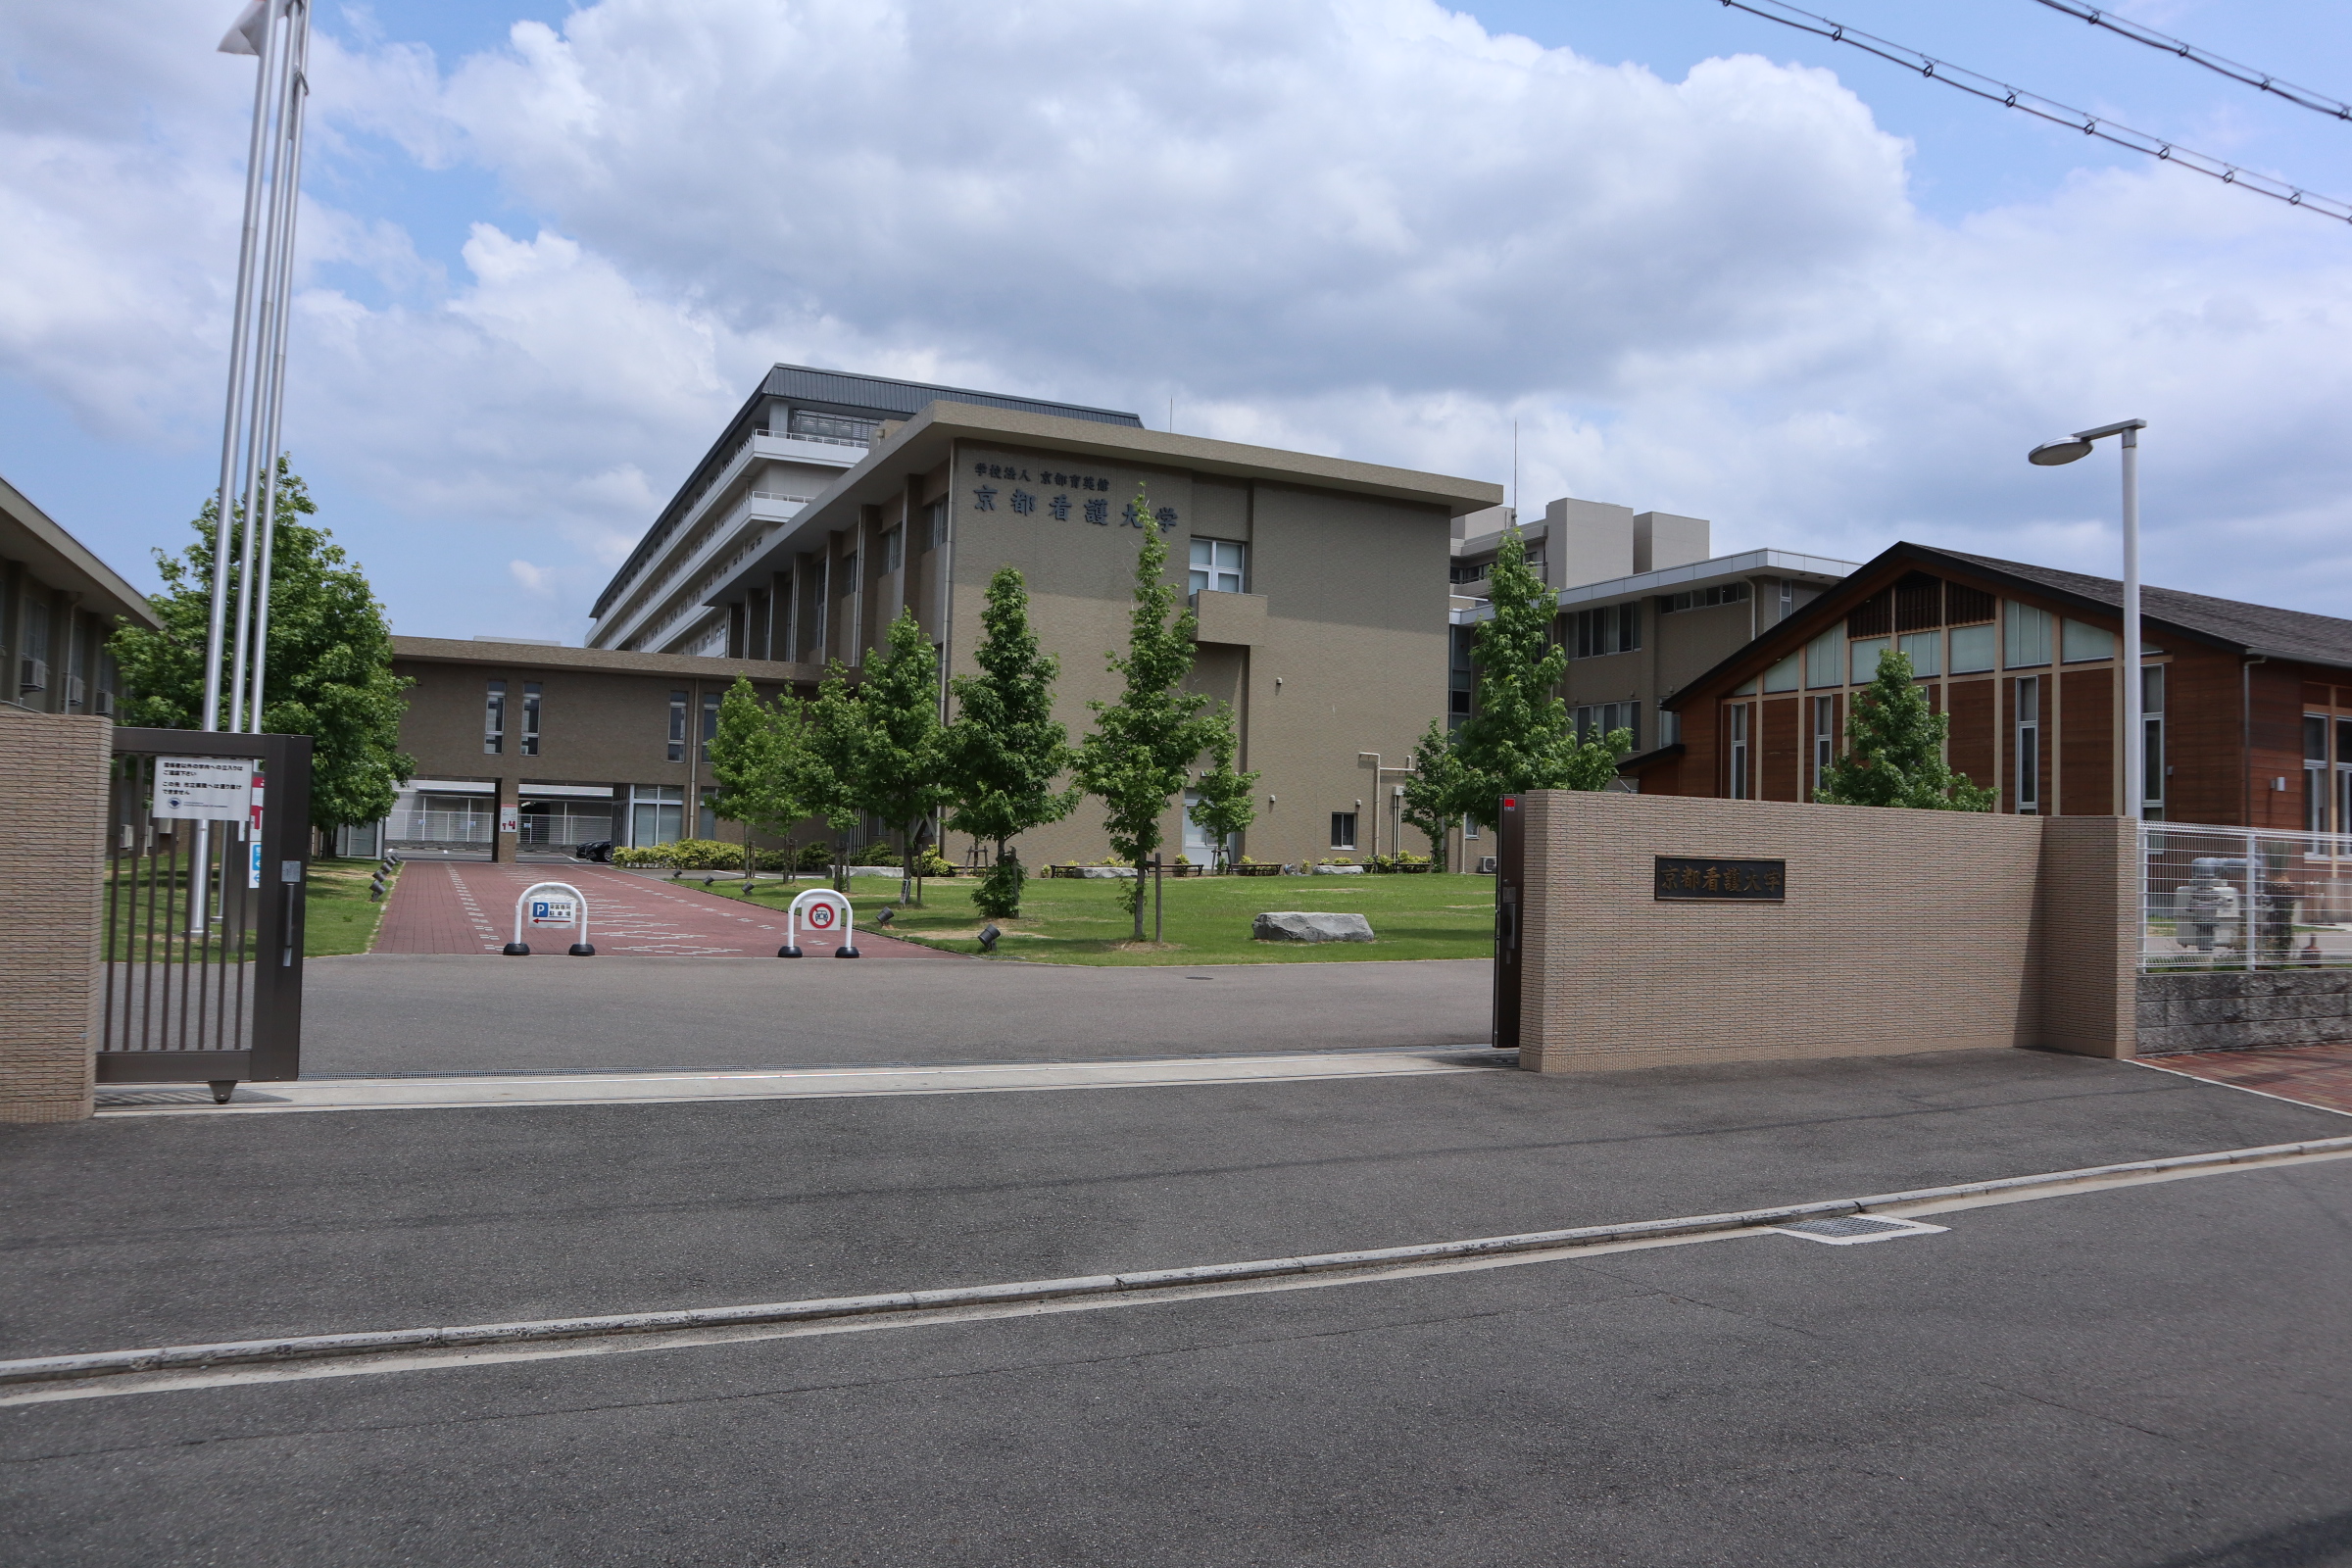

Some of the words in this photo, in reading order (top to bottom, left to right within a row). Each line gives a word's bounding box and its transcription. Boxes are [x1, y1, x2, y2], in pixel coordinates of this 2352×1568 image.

[975, 462, 1031, 482] 学校法人
[1040, 471, 1109, 492] 京都育英館
[973, 484, 1179, 533] 京都看護大学
[1660, 864, 1782, 893] 京都看護大学
[536, 904, 545, 915] P
